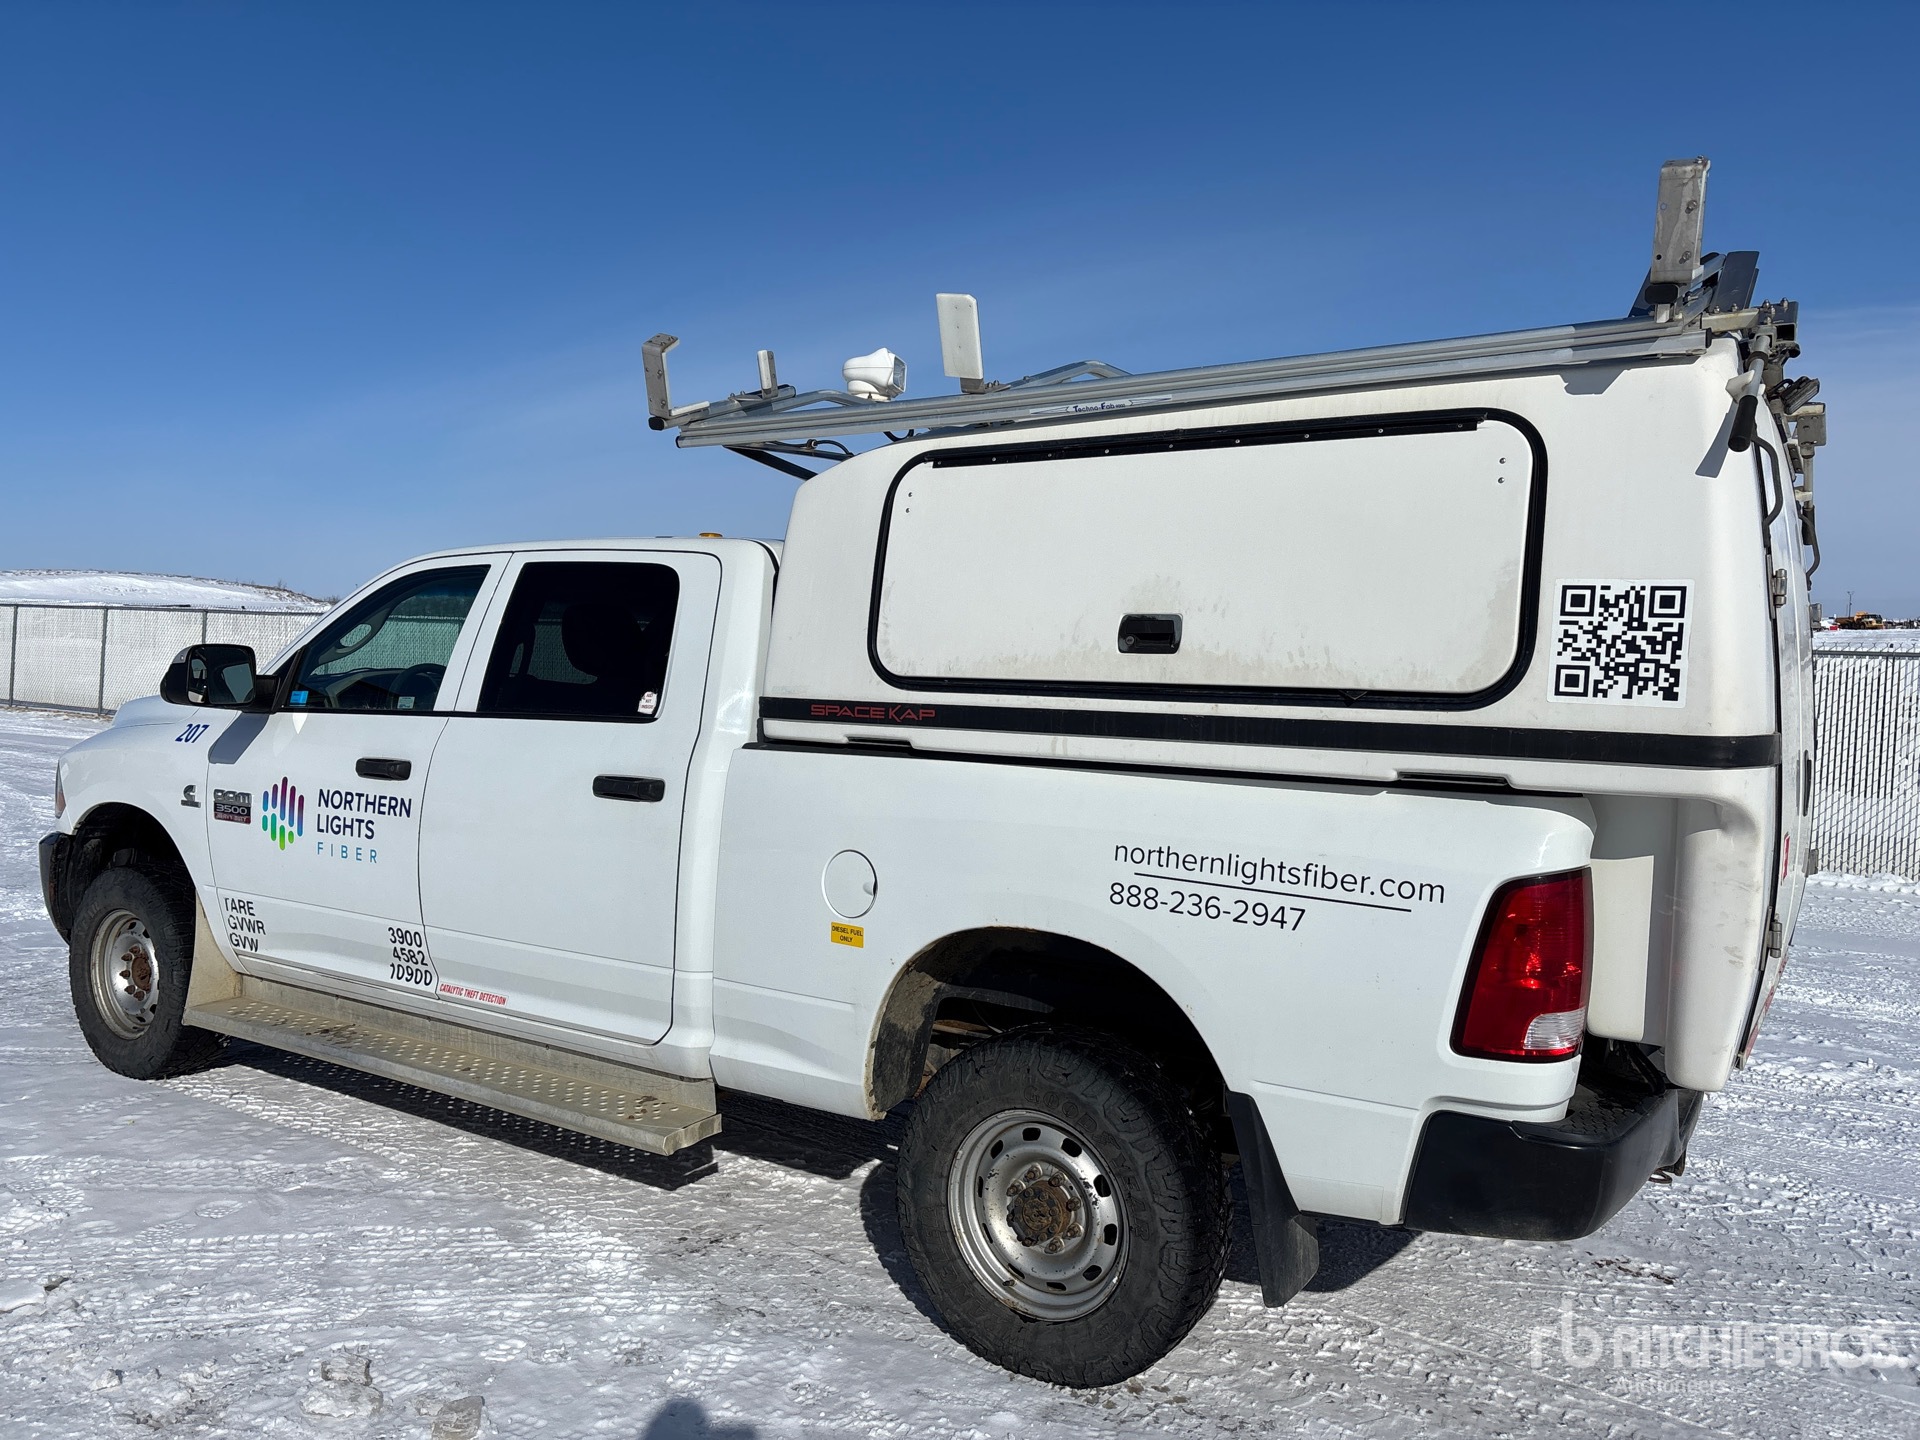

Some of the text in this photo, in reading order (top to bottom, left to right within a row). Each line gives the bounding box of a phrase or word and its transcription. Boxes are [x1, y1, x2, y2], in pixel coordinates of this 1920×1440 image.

[175, 723, 209, 743] 207
[216, 803, 248, 815] 3500
[317, 788, 412, 818] NORTHERN
[316, 813, 375, 839] LIGHTS
[317, 842, 377, 863] FIBER
[1114, 843, 1445, 903] northernlightsfiber.com
[1109, 882, 1306, 931] 888-236-2947
[227, 915, 266, 935] GVWR
[832, 926, 863, 937] DIESEL FUEL
[229, 932, 259, 952] GVW
[387, 927, 422, 948] 3900
[392, 946, 429, 966] 4582
[440, 983, 506, 1005] CATALYTIC THEFT DETECTION
